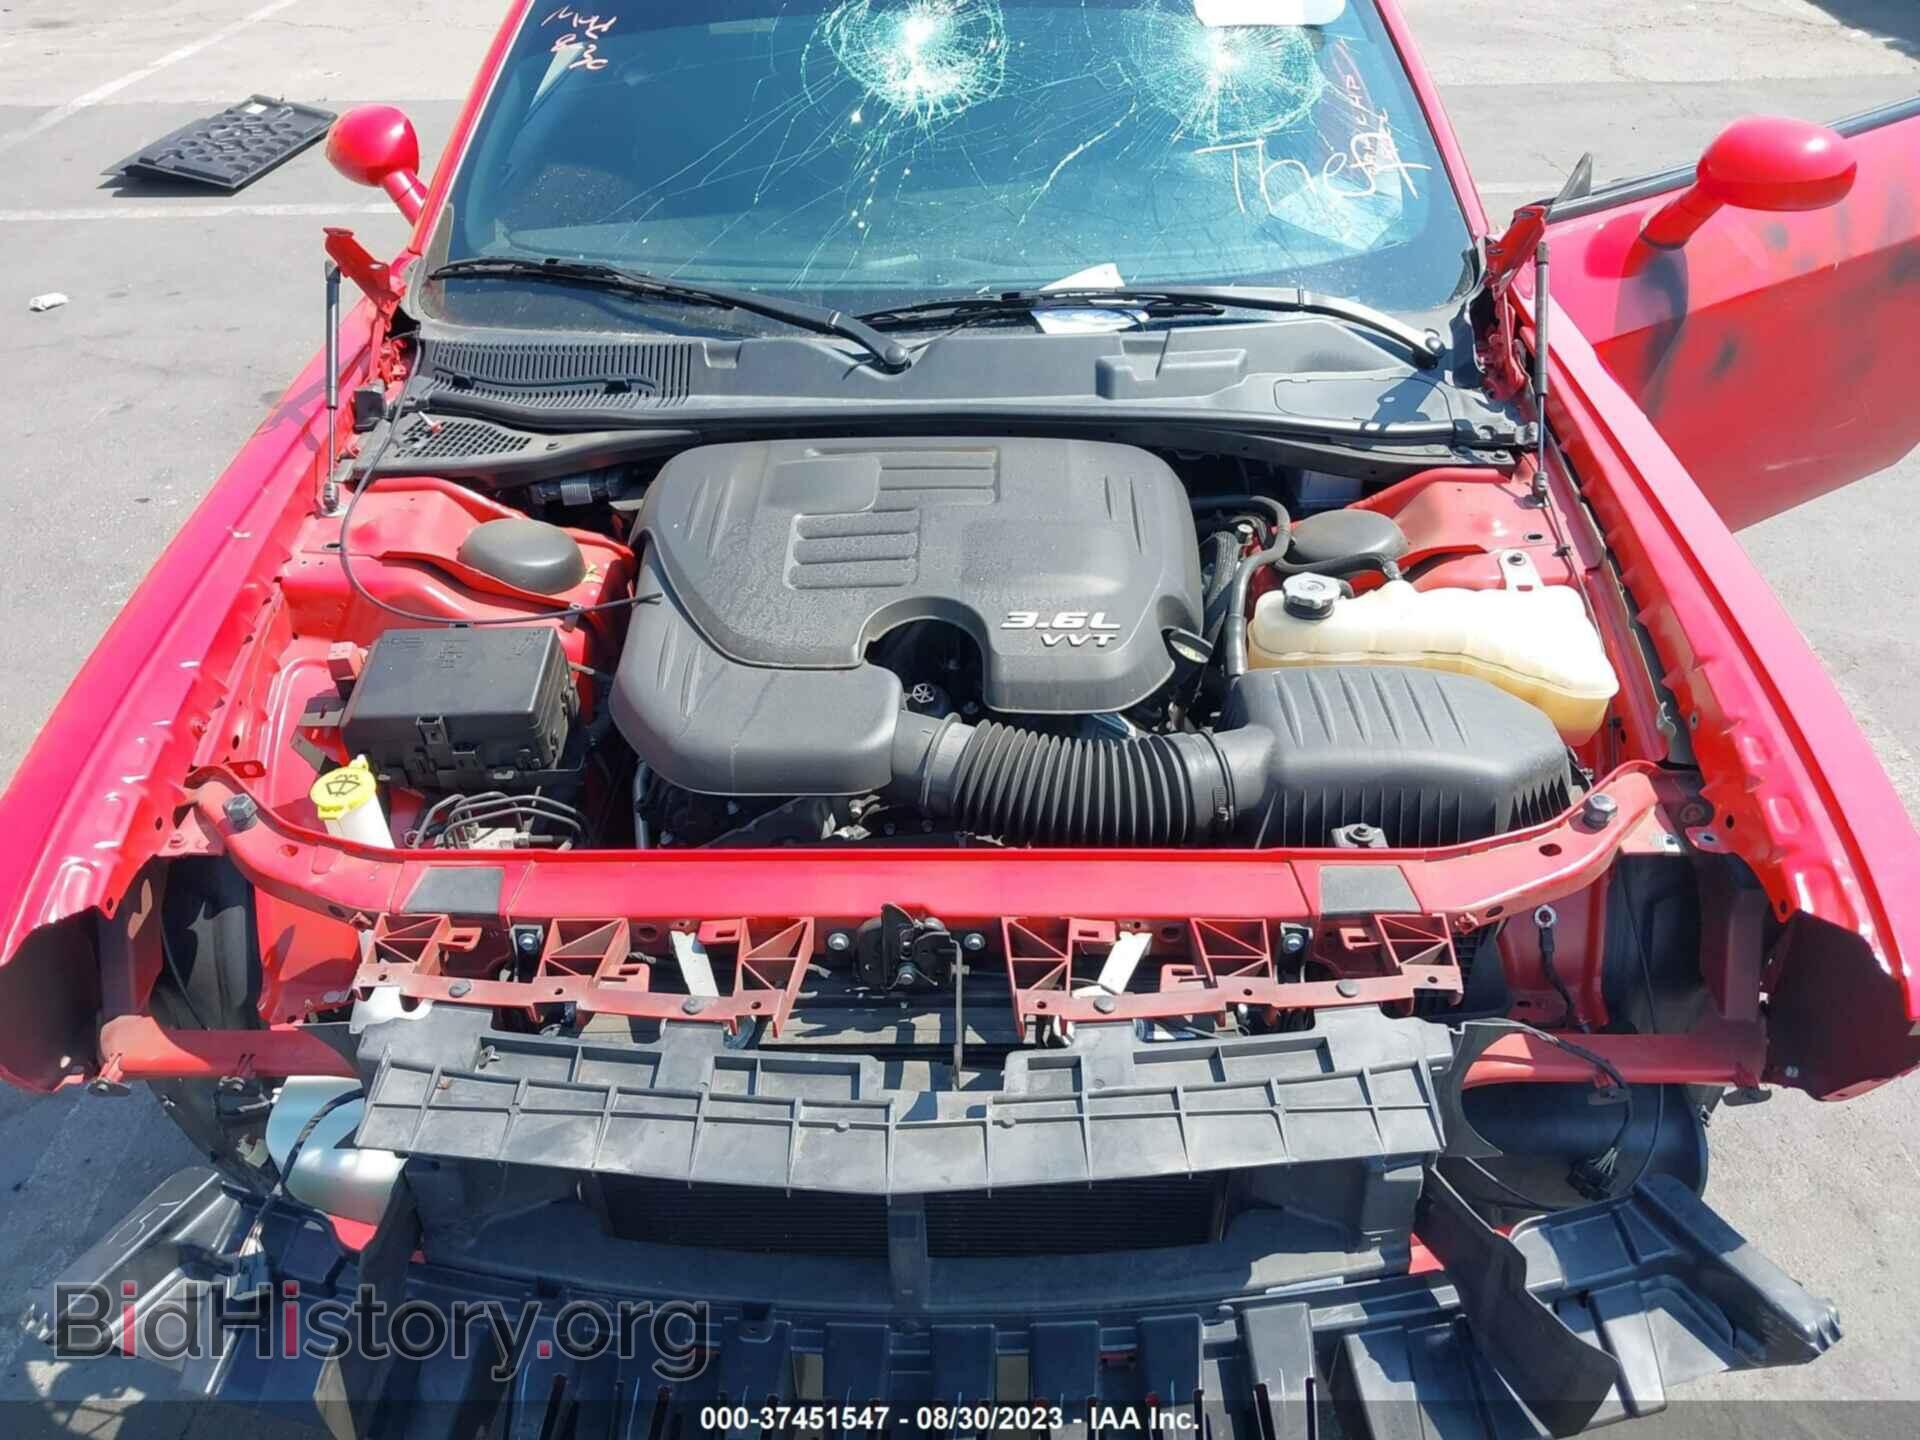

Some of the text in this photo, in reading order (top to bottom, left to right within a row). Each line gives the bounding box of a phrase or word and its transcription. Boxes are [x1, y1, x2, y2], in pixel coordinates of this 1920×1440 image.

[1194, 130, 1432, 214] Theft
[1000, 611, 1121, 631] 3.6L
[1040, 633, 1118, 648] VVT
